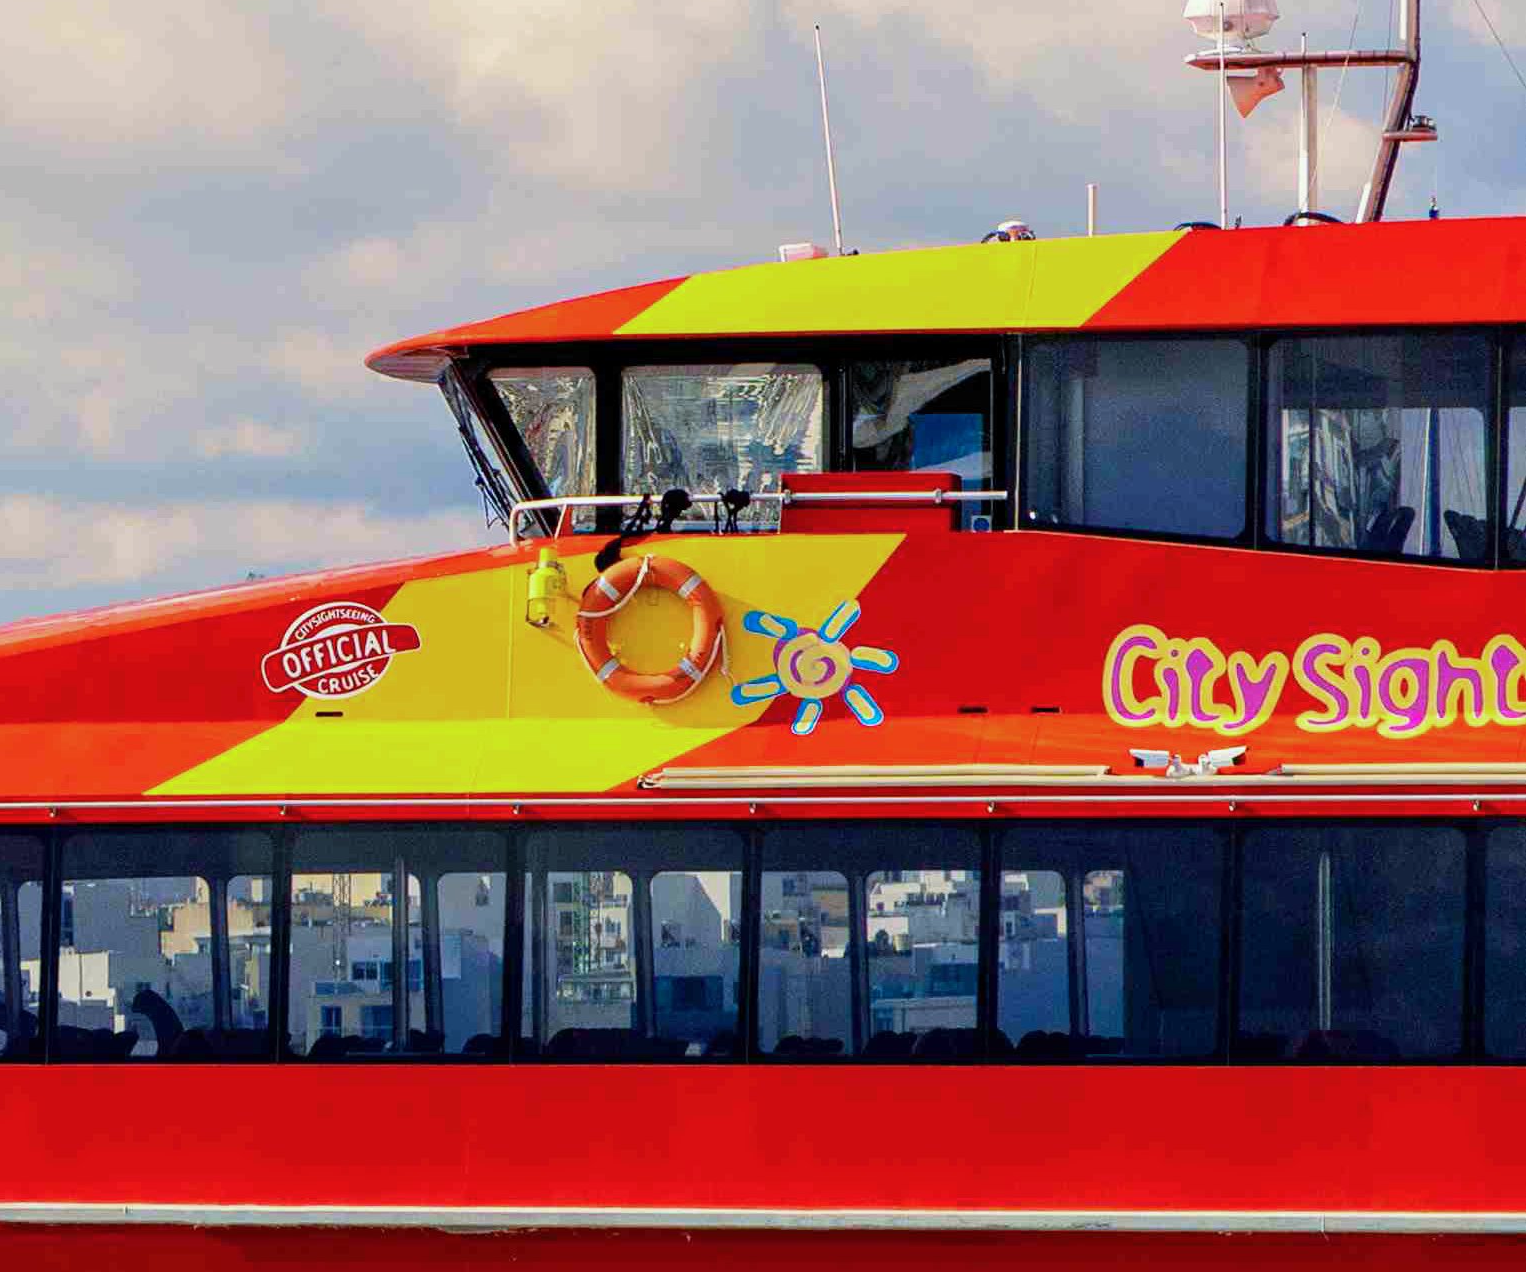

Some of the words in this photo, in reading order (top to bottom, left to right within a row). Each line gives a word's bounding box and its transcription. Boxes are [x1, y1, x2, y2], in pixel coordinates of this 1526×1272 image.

[282, 629, 396, 678] OFFICIAL
[317, 663, 379, 695] CRUISE
[1103, 624, 1289, 736] City
